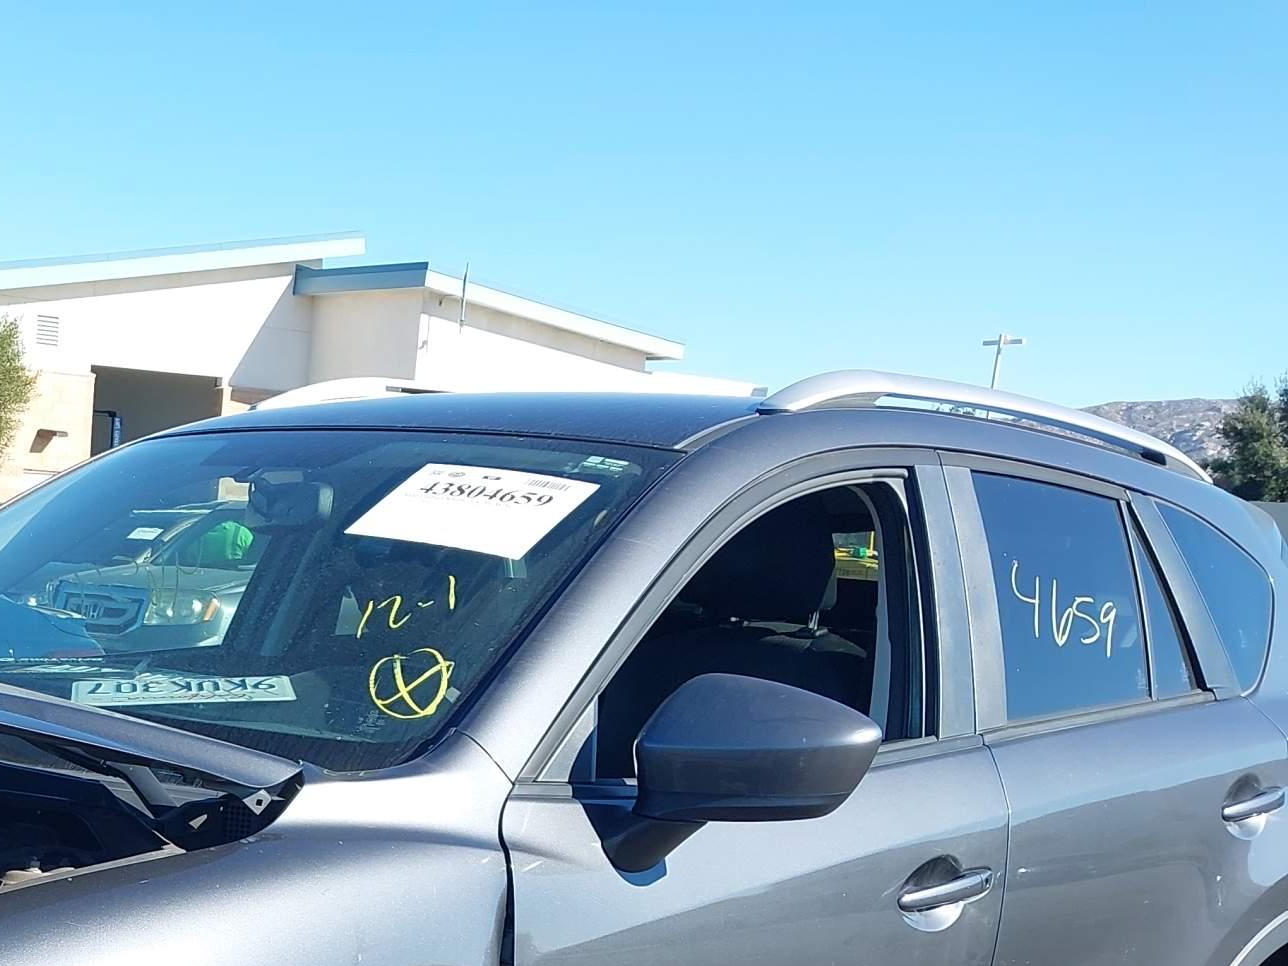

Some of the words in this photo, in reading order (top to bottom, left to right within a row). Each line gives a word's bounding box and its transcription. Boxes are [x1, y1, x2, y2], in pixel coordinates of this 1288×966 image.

[419, 481, 554, 507] 43804659
[1011, 560, 1117, 659] 4659
[87, 678, 276, 695] 9KUK307
